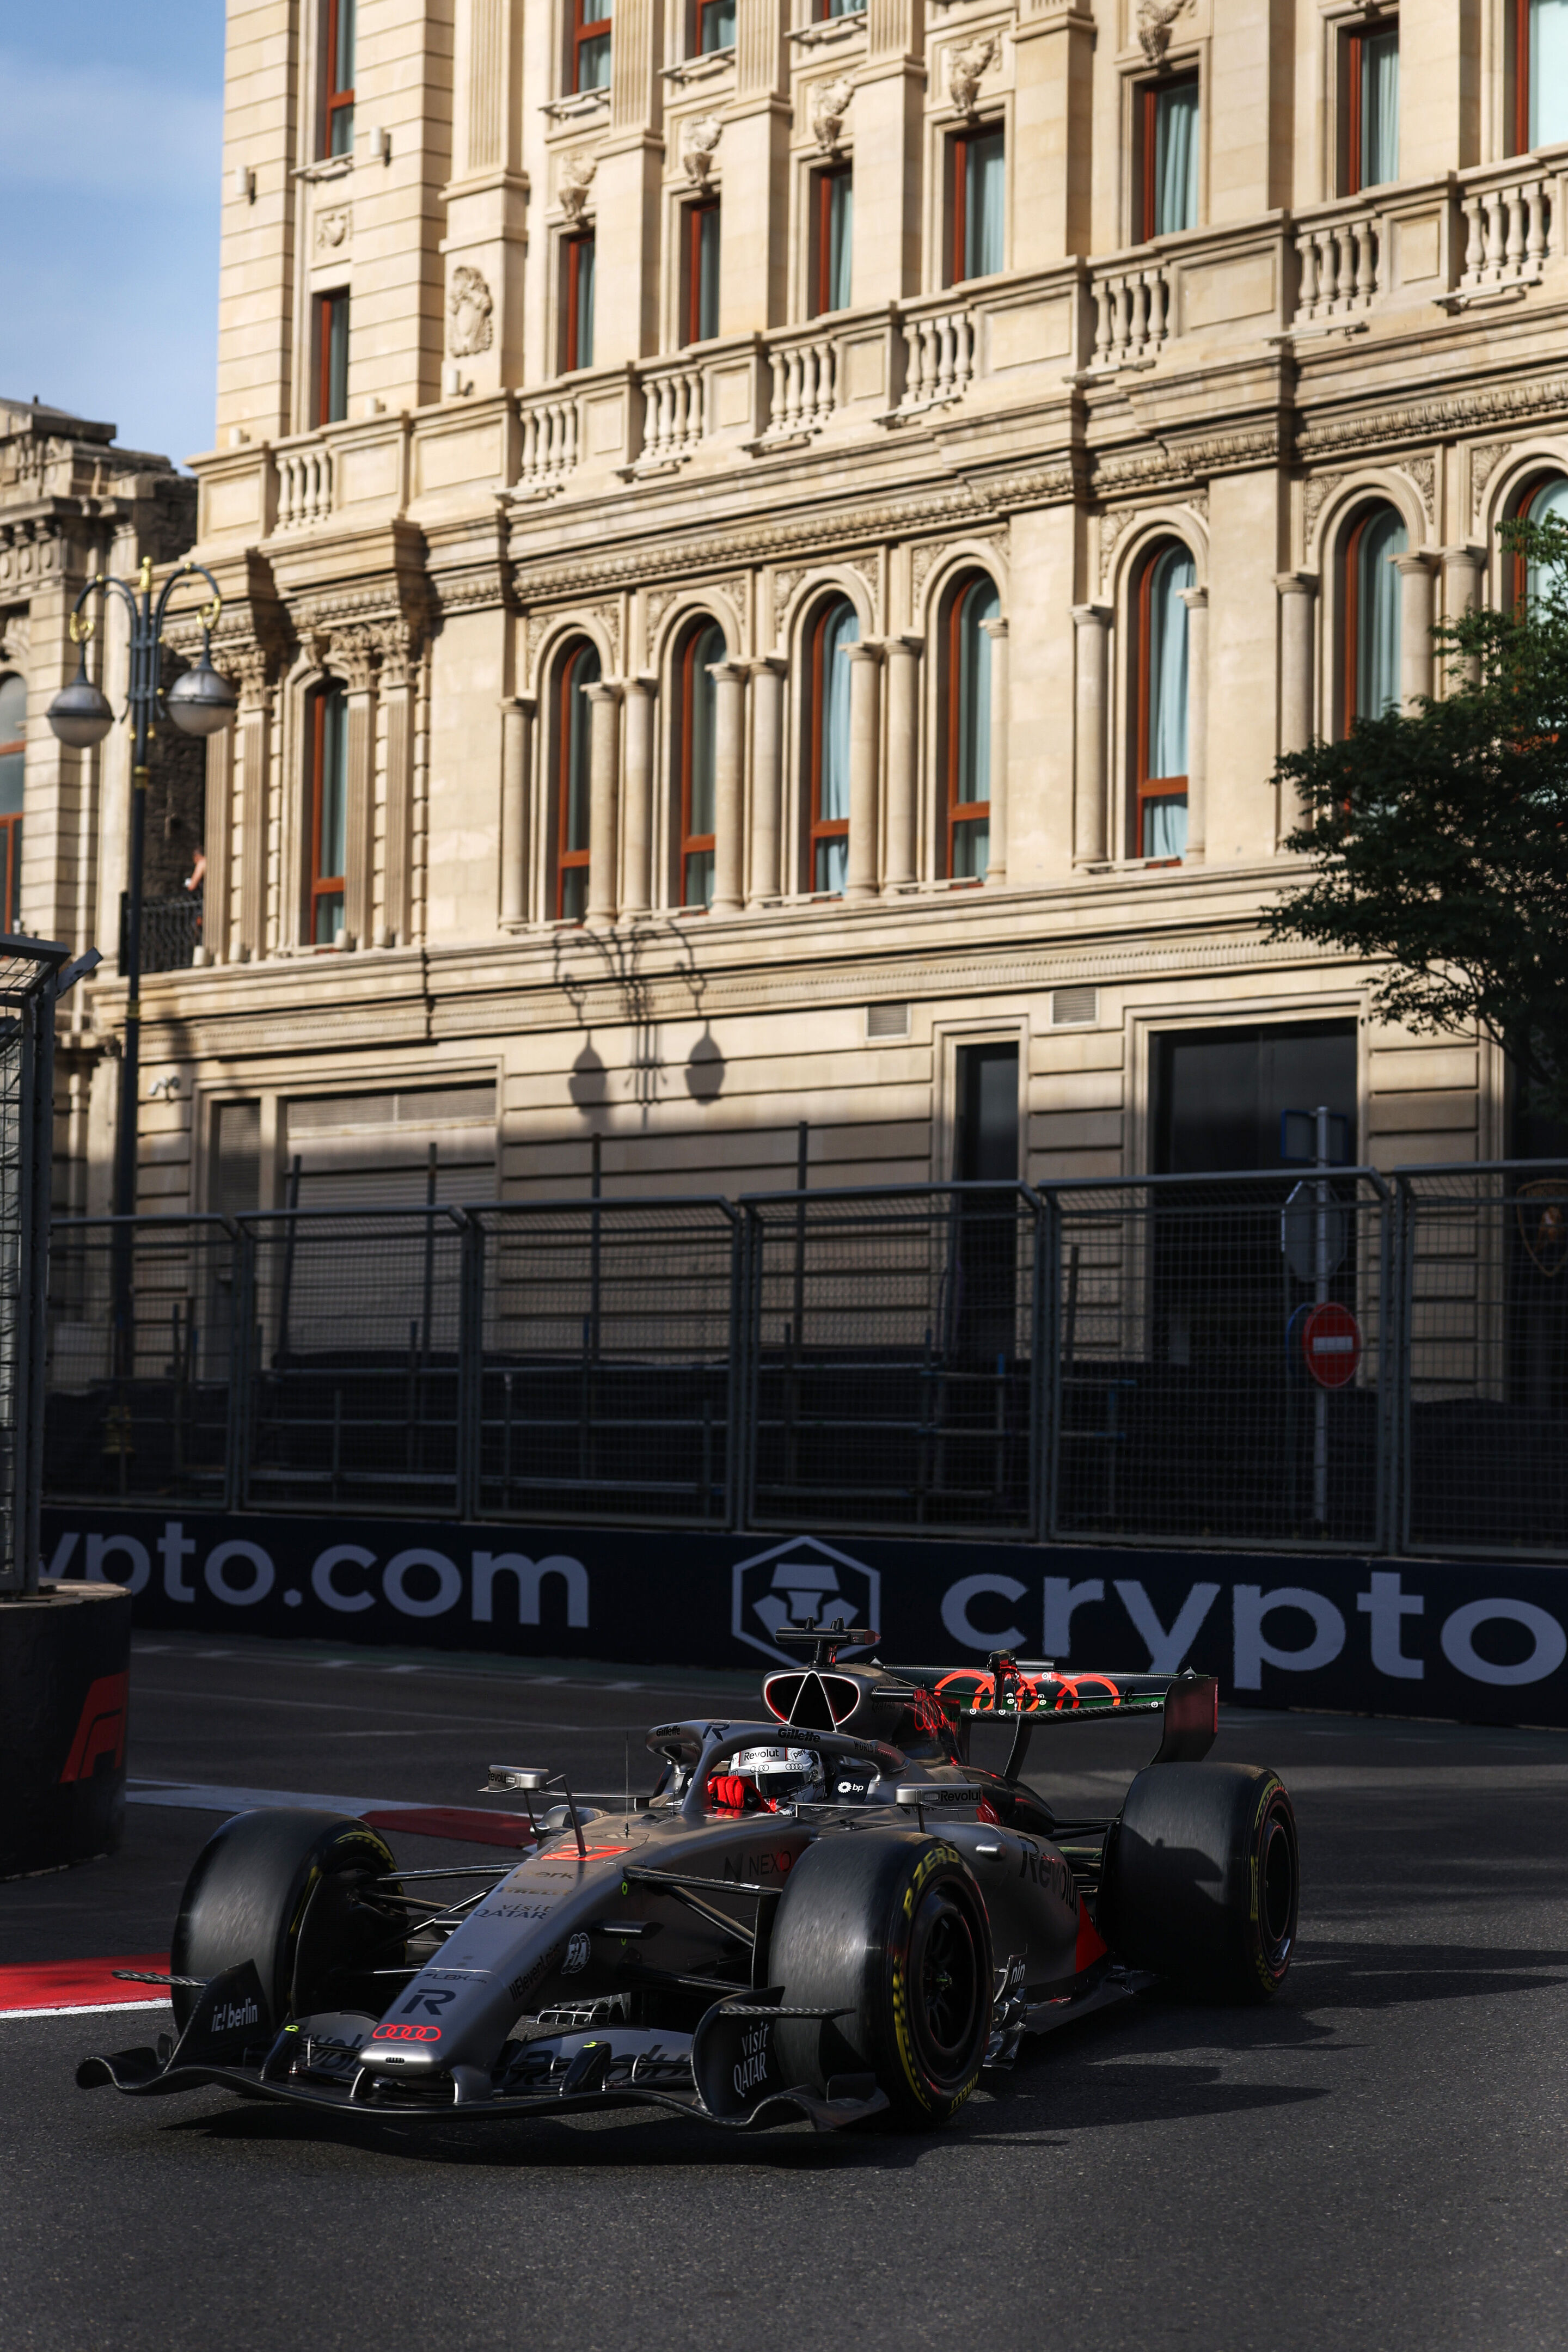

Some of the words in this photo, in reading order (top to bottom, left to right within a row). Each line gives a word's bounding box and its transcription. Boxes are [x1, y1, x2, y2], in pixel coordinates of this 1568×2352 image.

[940, 1571, 1568, 1691] crypto
[777, 1728, 821, 1743] Gillette
[744, 1749, 779, 1761] Revolut
[852, 1783, 864, 1792] bp
[540, 1844, 633, 1861] 27
[749, 1850, 792, 1878] NEXO
[473, 1908, 548, 1920] QATAR
[501, 1903, 554, 1912] visit
[226, 1997, 258, 2029] berlin
[401, 1989, 456, 2016] R
[742, 2020, 770, 2056] visit
[733, 2051, 768, 2098] QATAR
